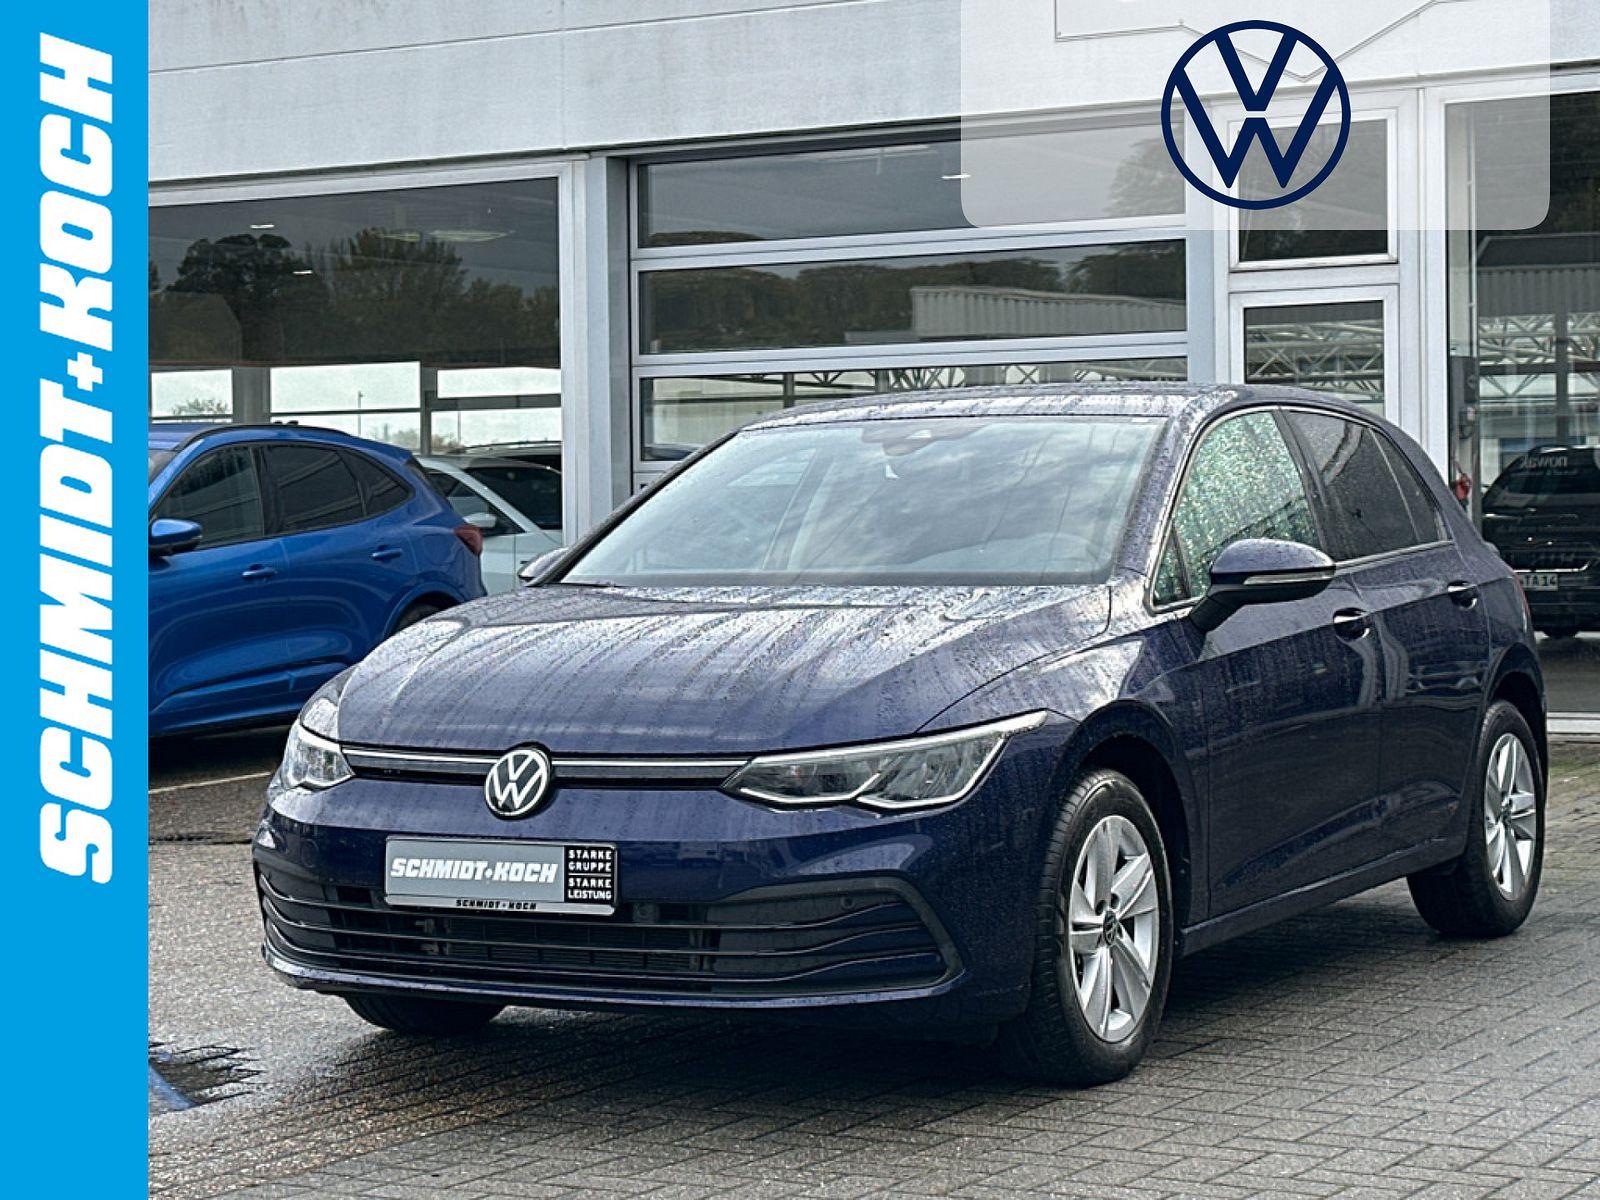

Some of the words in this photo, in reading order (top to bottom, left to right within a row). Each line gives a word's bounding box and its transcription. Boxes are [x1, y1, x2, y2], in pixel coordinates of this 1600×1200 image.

[568, 849, 612, 860] STARKE
[568, 861, 612, 872] GRUPPE
[568, 877, 612, 888] STARKE
[568, 888, 612, 900] LEISTUNG
